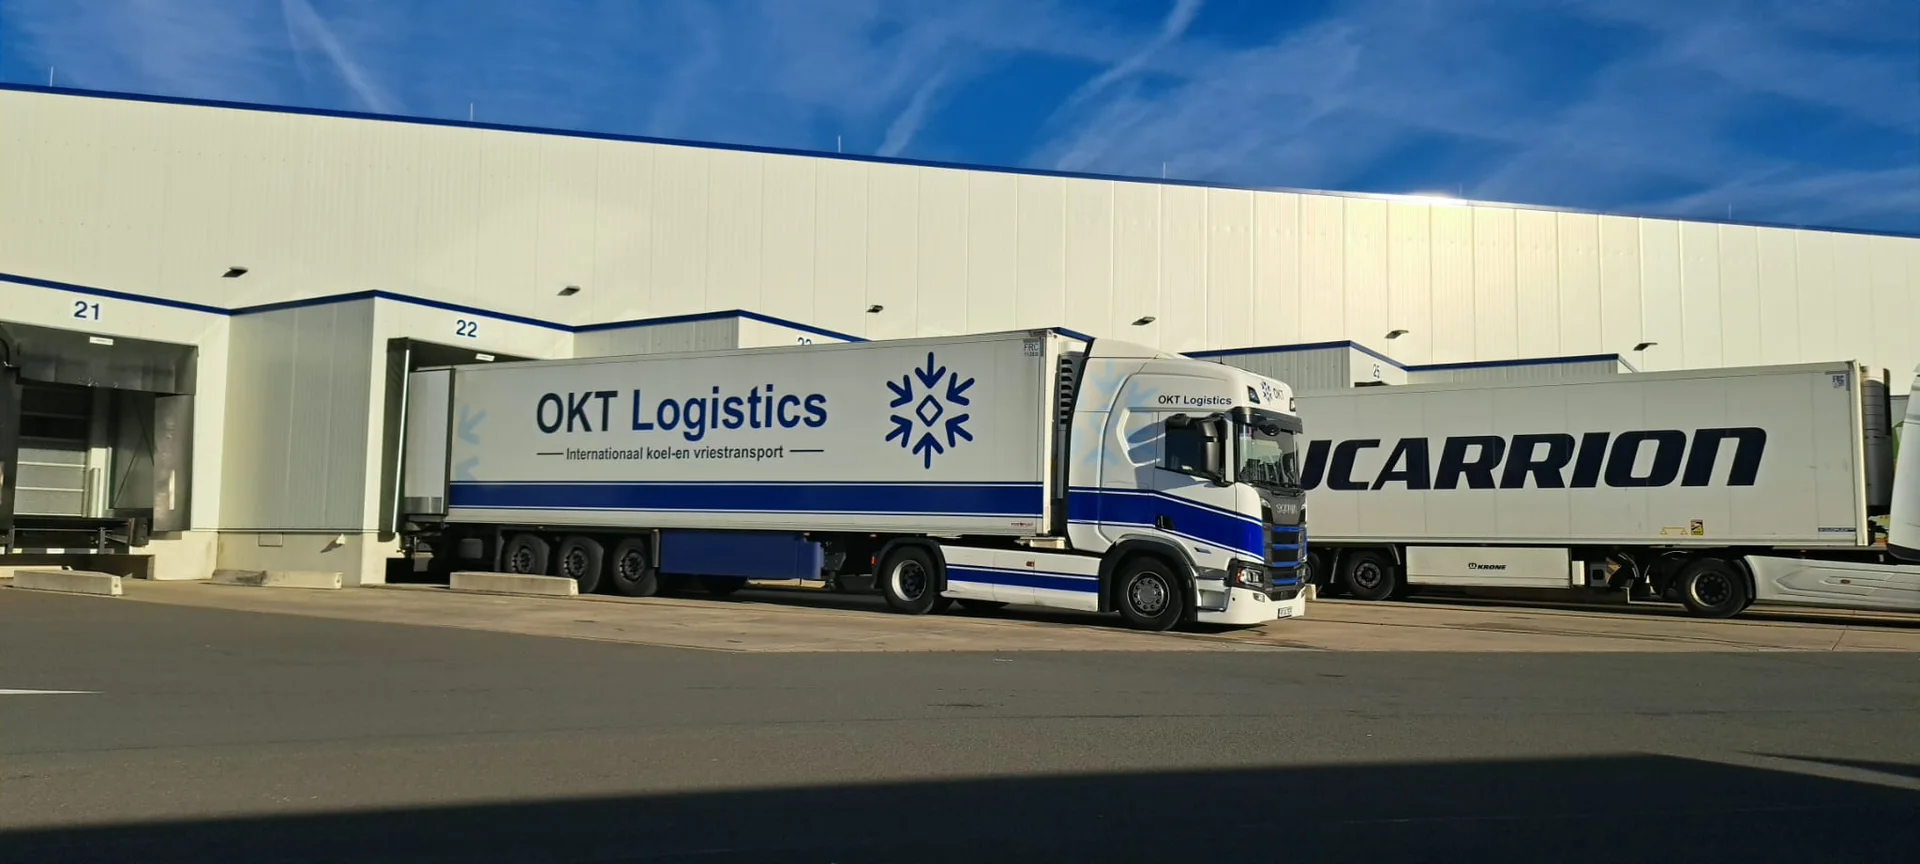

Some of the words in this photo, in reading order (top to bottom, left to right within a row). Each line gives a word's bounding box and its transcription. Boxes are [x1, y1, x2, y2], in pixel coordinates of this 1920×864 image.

[74, 300, 99, 320] 21
[456, 319, 477, 338] 22
[1158, 394, 1181, 405] OKT
[1183, 395, 1232, 407] Logistics
[536, 390, 618, 434] OKT
[632, 384, 828, 442] Logistics
[566, 447, 643, 460] Internationaal
[646, 447, 690, 460] koel-en
[693, 445, 784, 462] vriestransport
